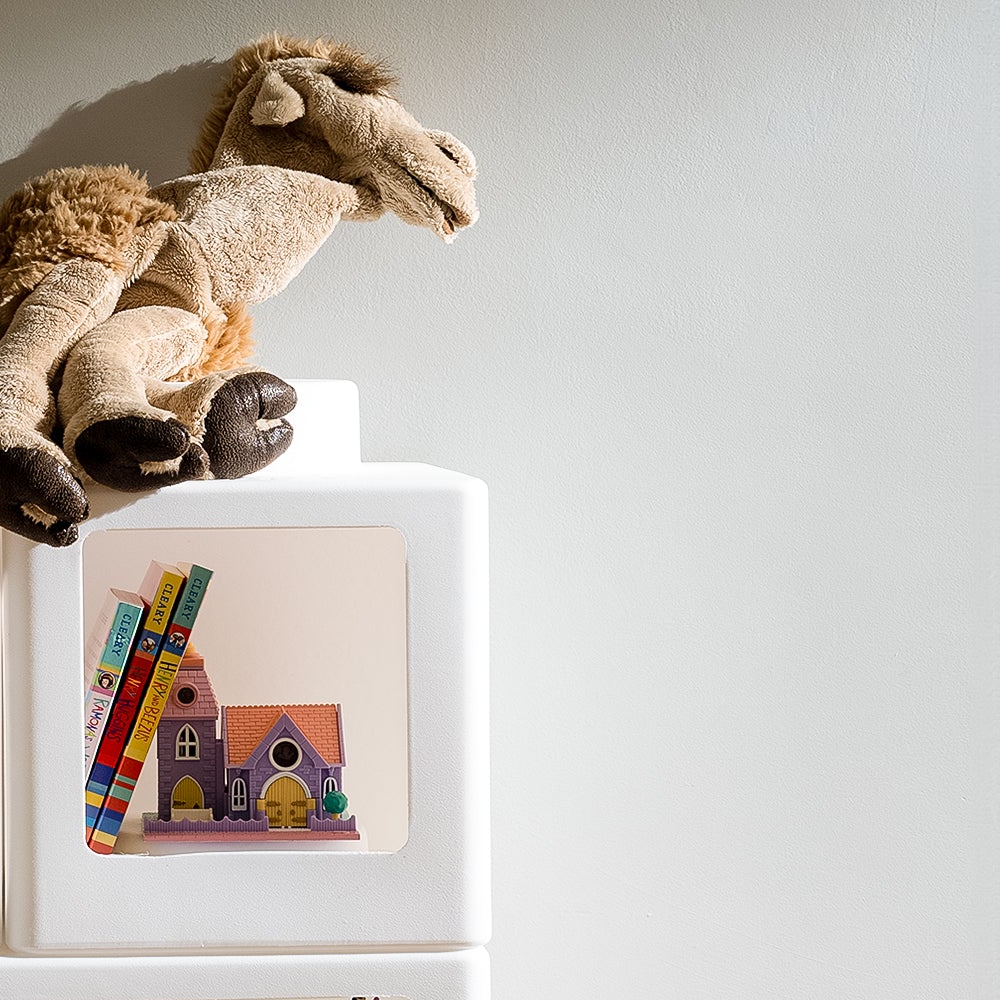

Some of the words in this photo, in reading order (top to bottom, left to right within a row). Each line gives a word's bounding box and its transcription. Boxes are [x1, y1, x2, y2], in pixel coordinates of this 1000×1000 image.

[153, 583, 173, 625] CLEARY
[182, 578, 202, 620] CLEARY
[112, 613, 132, 656] CLEARY
[151, 694, 160, 706] AND
[153, 661, 178, 698] HENRY
[108, 697, 135, 743] HUGGINS
[134, 705, 160, 742] BEEZUS
